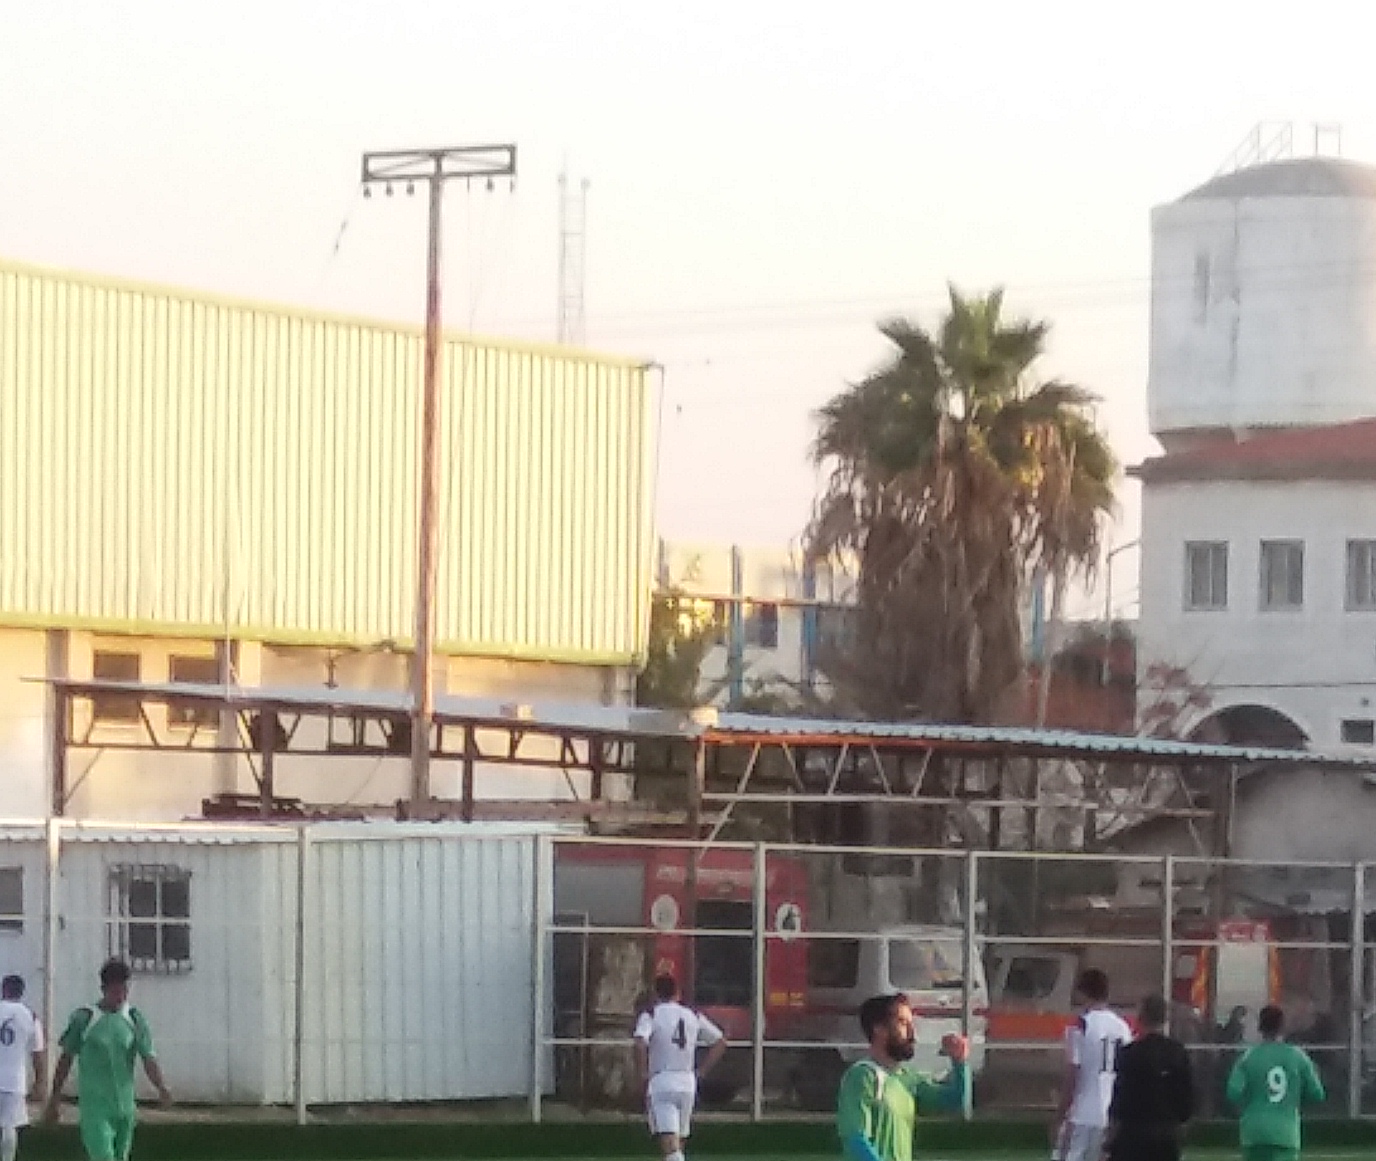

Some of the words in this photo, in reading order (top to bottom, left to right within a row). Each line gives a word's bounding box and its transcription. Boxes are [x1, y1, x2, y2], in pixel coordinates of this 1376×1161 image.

[0, 1014, 16, 1047] 6
[671, 1017, 687, 1049] 4
[1267, 1065, 1288, 1103] 9
